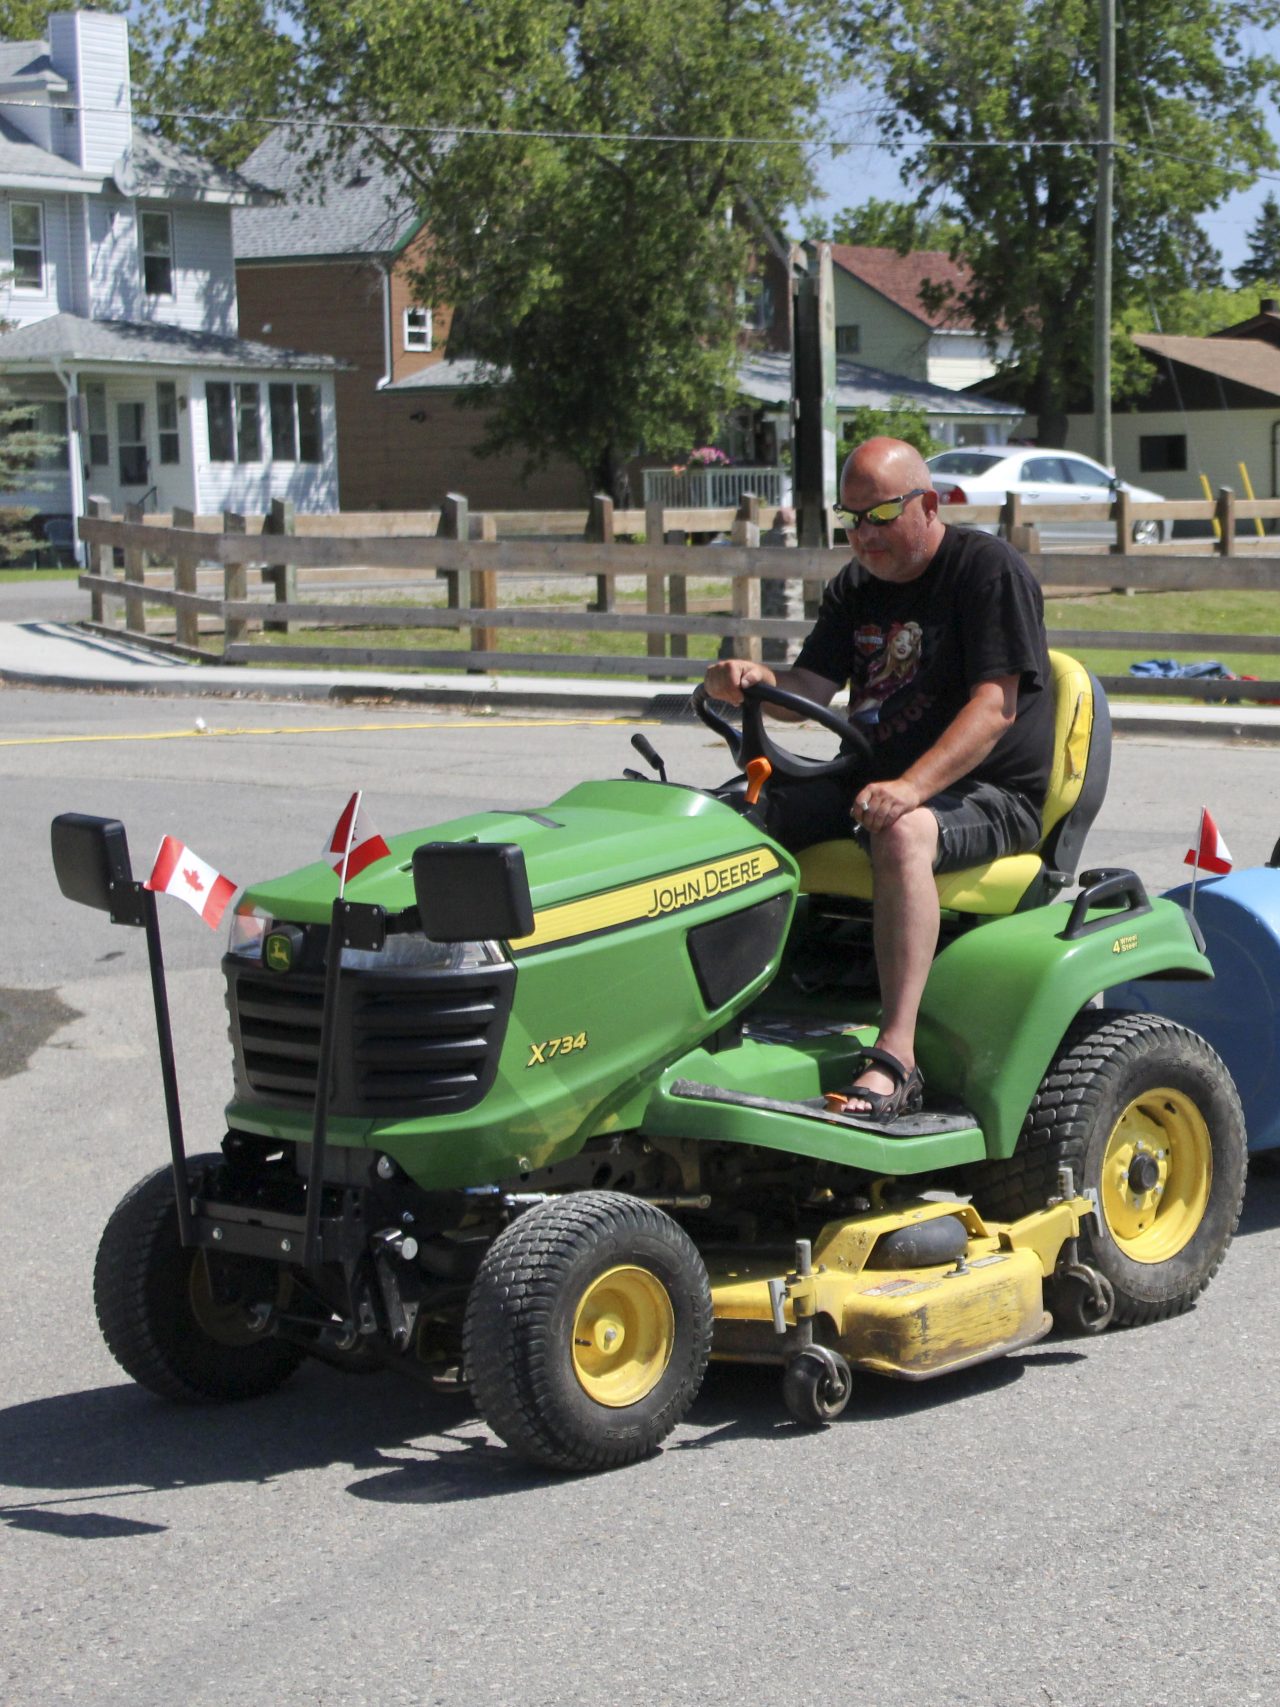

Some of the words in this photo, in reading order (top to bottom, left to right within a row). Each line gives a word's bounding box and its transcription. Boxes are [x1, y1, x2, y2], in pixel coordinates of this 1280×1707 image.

[648, 879, 701, 914] JOHN
[704, 857, 761, 894] DEERE
[1112, 938, 1121, 953] 4
[527, 1032, 587, 1067] X734
